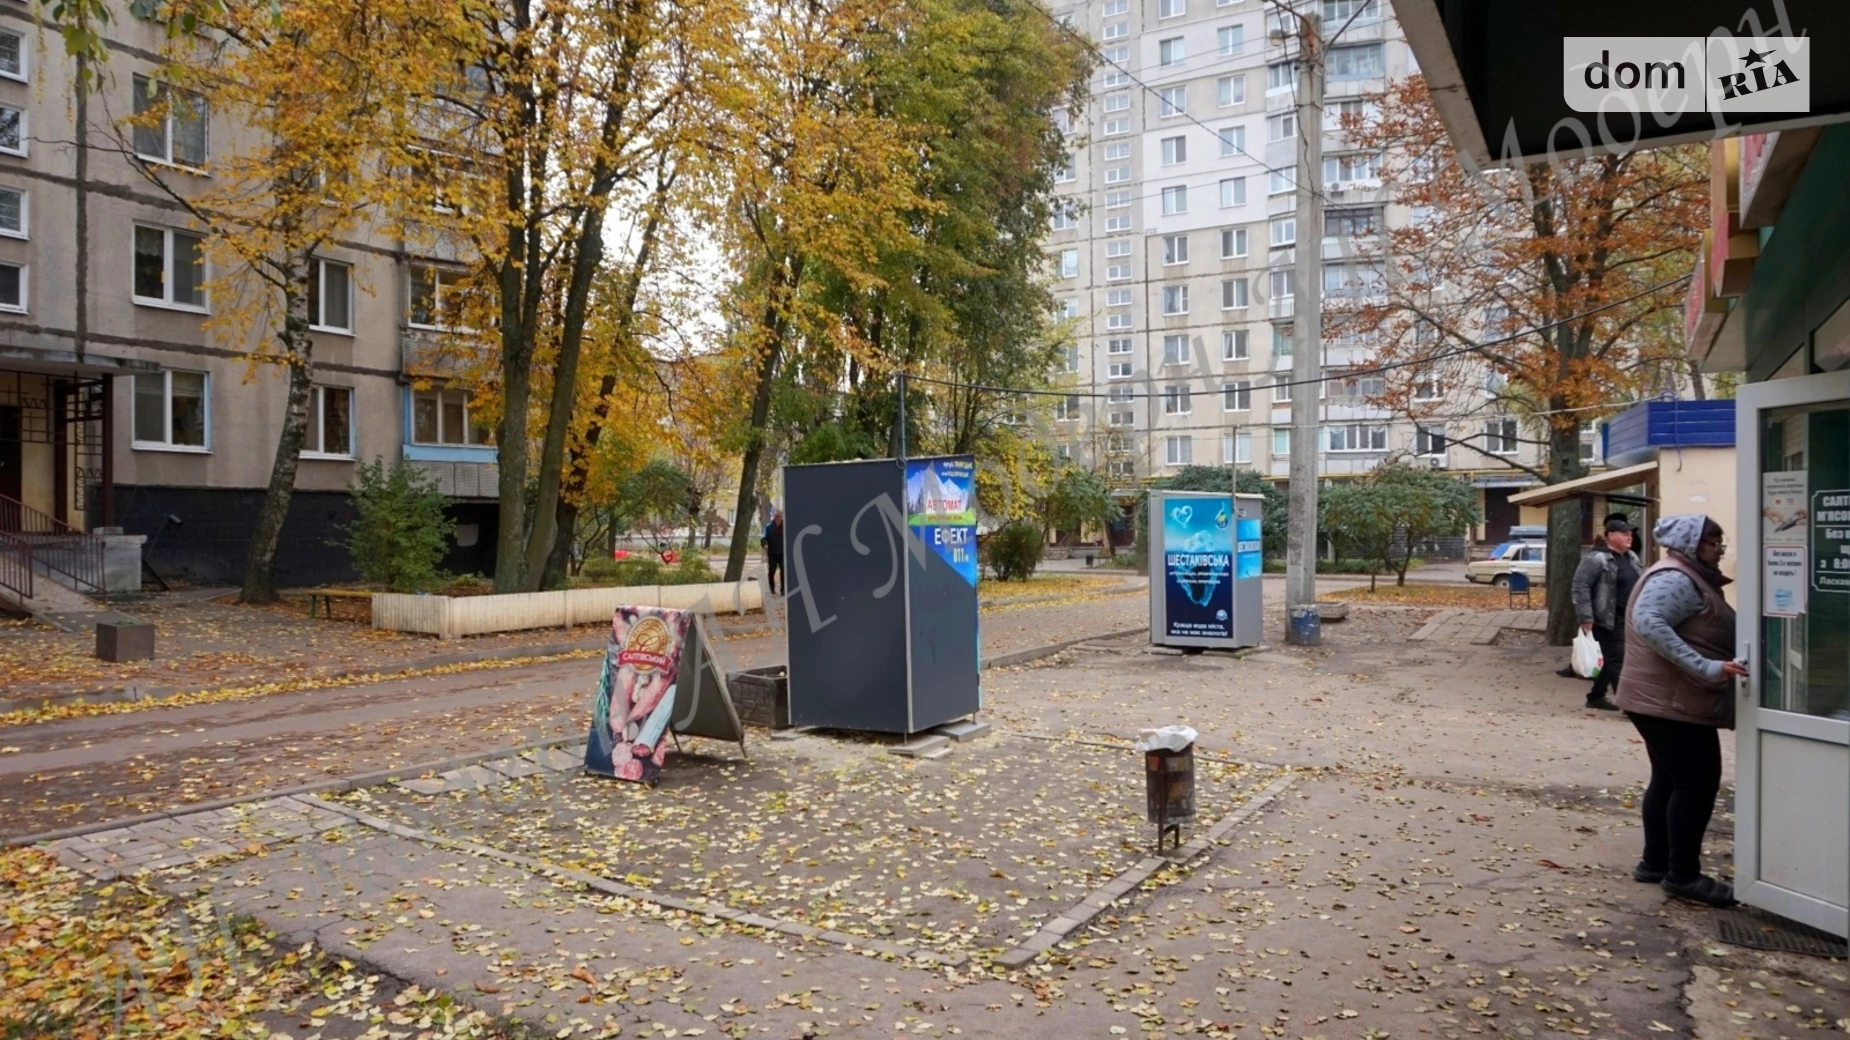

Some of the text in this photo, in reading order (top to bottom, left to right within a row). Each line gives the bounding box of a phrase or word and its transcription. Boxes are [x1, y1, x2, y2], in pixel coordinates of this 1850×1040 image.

[1823, 496, 1850, 507] САЛТ
[934, 527, 969, 545] ЕФЕКТ
[1825, 528, 1844, 539] Без
[1167, 554, 1230, 567] ШЕСТАКІВСЬКА
[1833, 558, 1850, 569] 8:0
[1173, 621, 1192, 629] Краща
